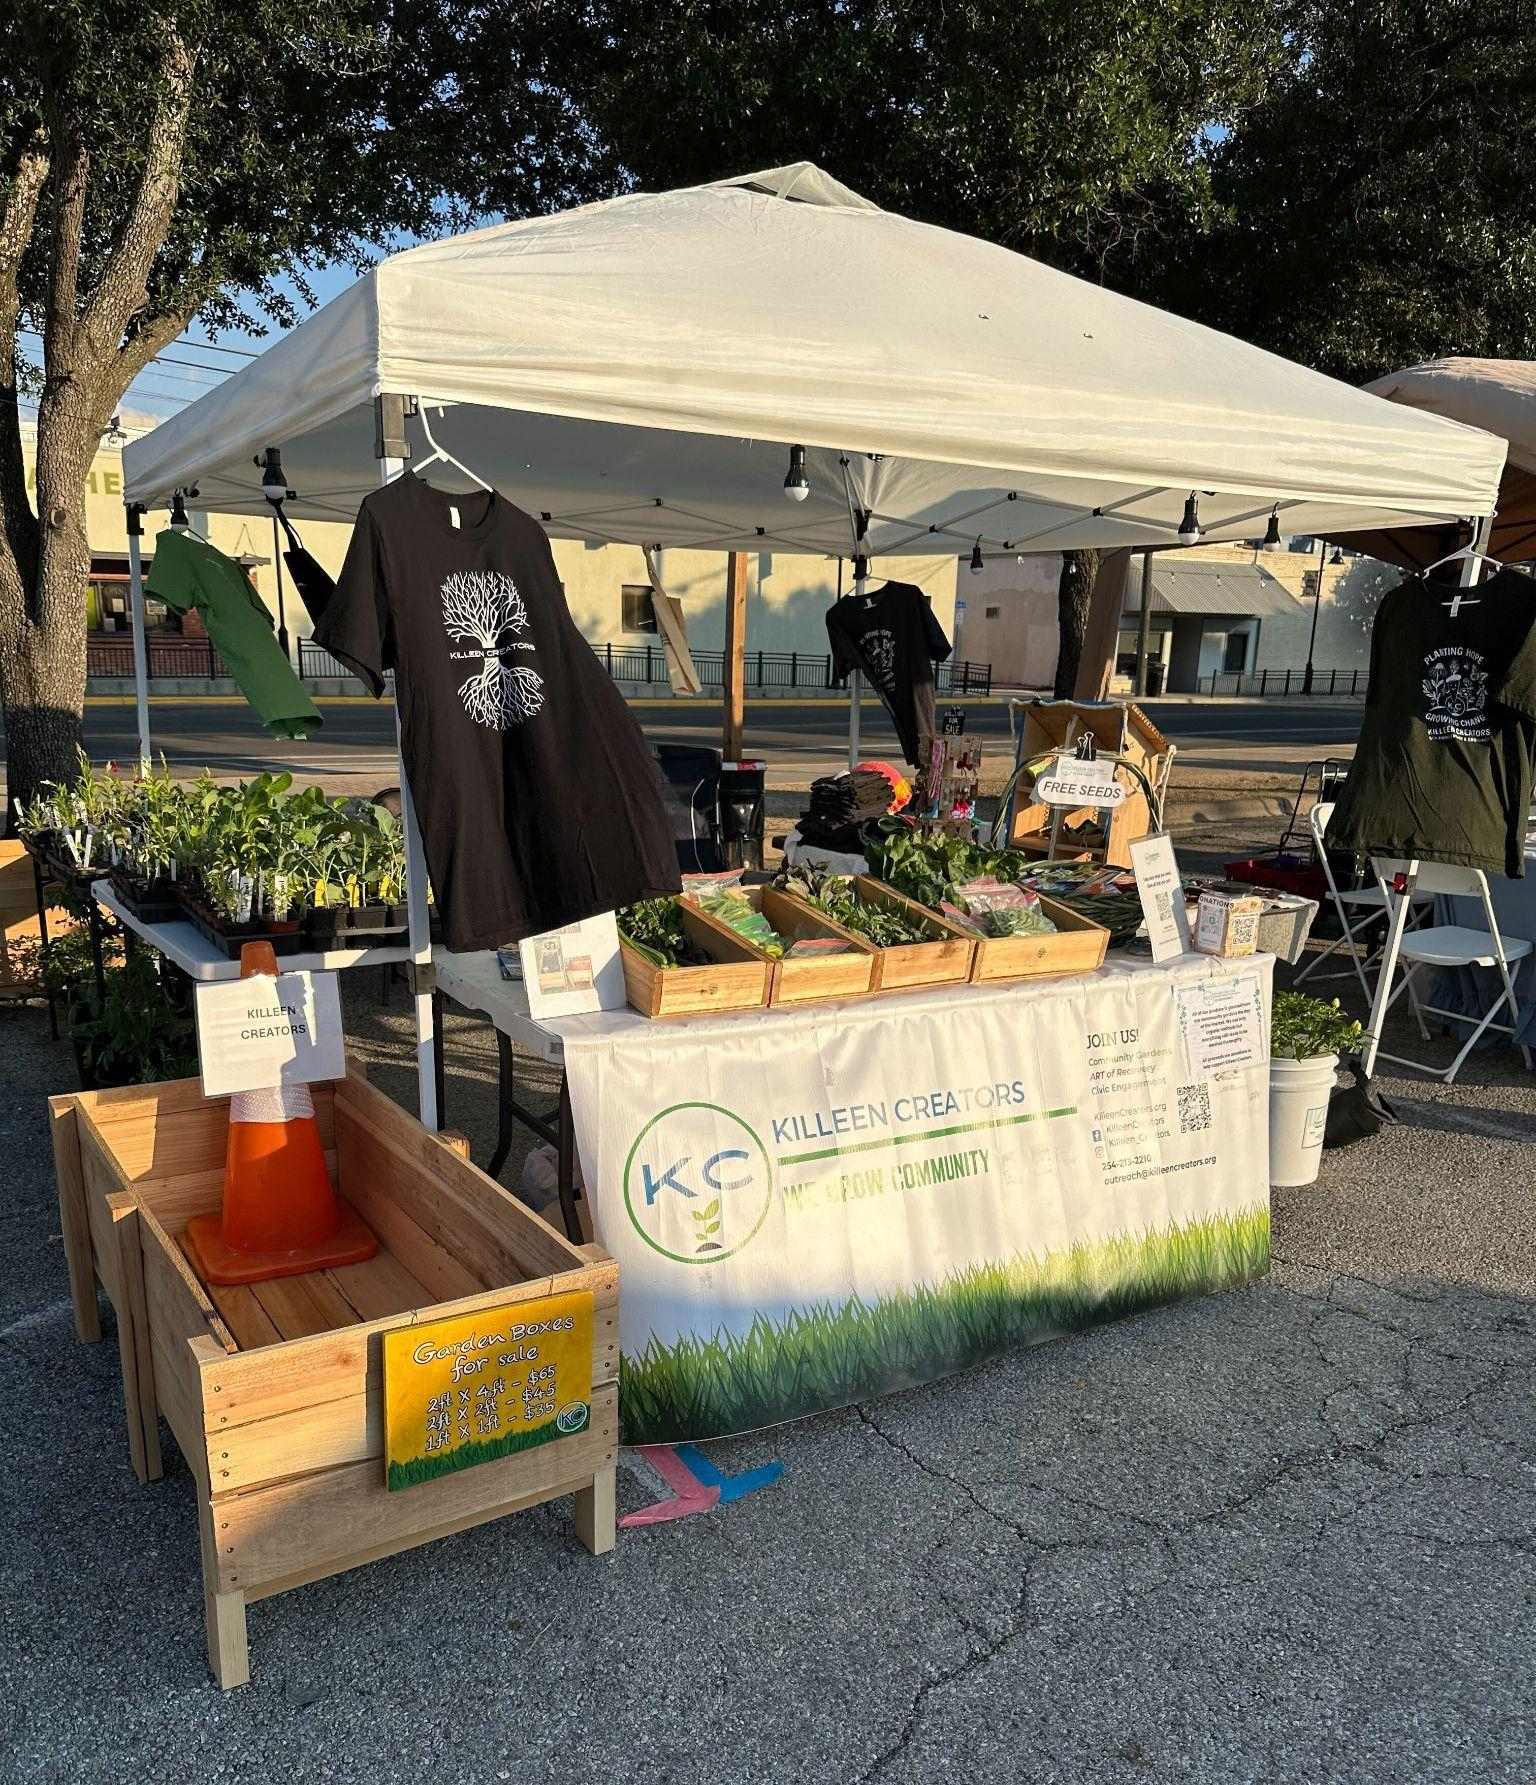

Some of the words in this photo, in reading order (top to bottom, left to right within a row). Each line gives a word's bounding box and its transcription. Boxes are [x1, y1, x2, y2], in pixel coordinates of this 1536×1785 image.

[450, 650, 485, 660] KILLEEN
[486, 642, 536, 657] CREATORS
[1424, 646, 1464, 666] PLANTING
[1466, 648, 1484, 664] HOPE
[1425, 713, 1459, 726] GROWING
[1460, 714, 1486, 726] CHANG
[944, 724, 960, 735] SALE
[1428, 726, 1456, 736] KILLEEN
[1456, 728, 1491, 737] CREATORS
[1043, 781, 1077, 795] FREE
[1079, 785, 1121, 799] SEEDS
[1200, 895, 1234, 909] ONATIONS
[247, 1006, 297, 1019] KILLEEN
[241, 1024, 306, 1040] CREATORS
[1086, 1032, 1117, 1050] JOIN
[1120, 1028, 1139, 1044] US!
[1088, 1052, 1134, 1067] Community
[1090, 1071, 1104, 1081] ART
[1106, 1068, 1115, 1078] of
[1091, 1084, 1110, 1096] Civic
[1112, 1077, 1167, 1093] Engagement
[771, 1101, 888, 1144] KILLEEN
[894, 1080, 1025, 1122] CREATORS
[1106, 1117, 1165, 1134] KilleenCtors
[1108, 1130, 1172, 1148] Killeen_Crtors
[891, 1148, 990, 1191] COMMUNITY
[1104, 1156, 1217, 1186] outreach@killeencreators.org
[413, 1332, 506, 1364] Garden
[510, 1316, 574, 1342] Boxes
[450, 1355, 489, 1384] for
[498, 1345, 539, 1366] sale
[426, 1392, 453, 1414] 2ft
[476, 1377, 506, 1398] 4ft
[528, 1364, 556, 1386] $65
[426, 1410, 451, 1431] 2ft
[474, 1398, 498, 1418] 2ft
[521, 1383, 556, 1405] $45
[424, 1430, 452, 1452] 1ft
[477, 1414, 501, 1434] 1ft
[523, 1400, 556, 1421] $35
[559, 1409, 588, 1429] KC
